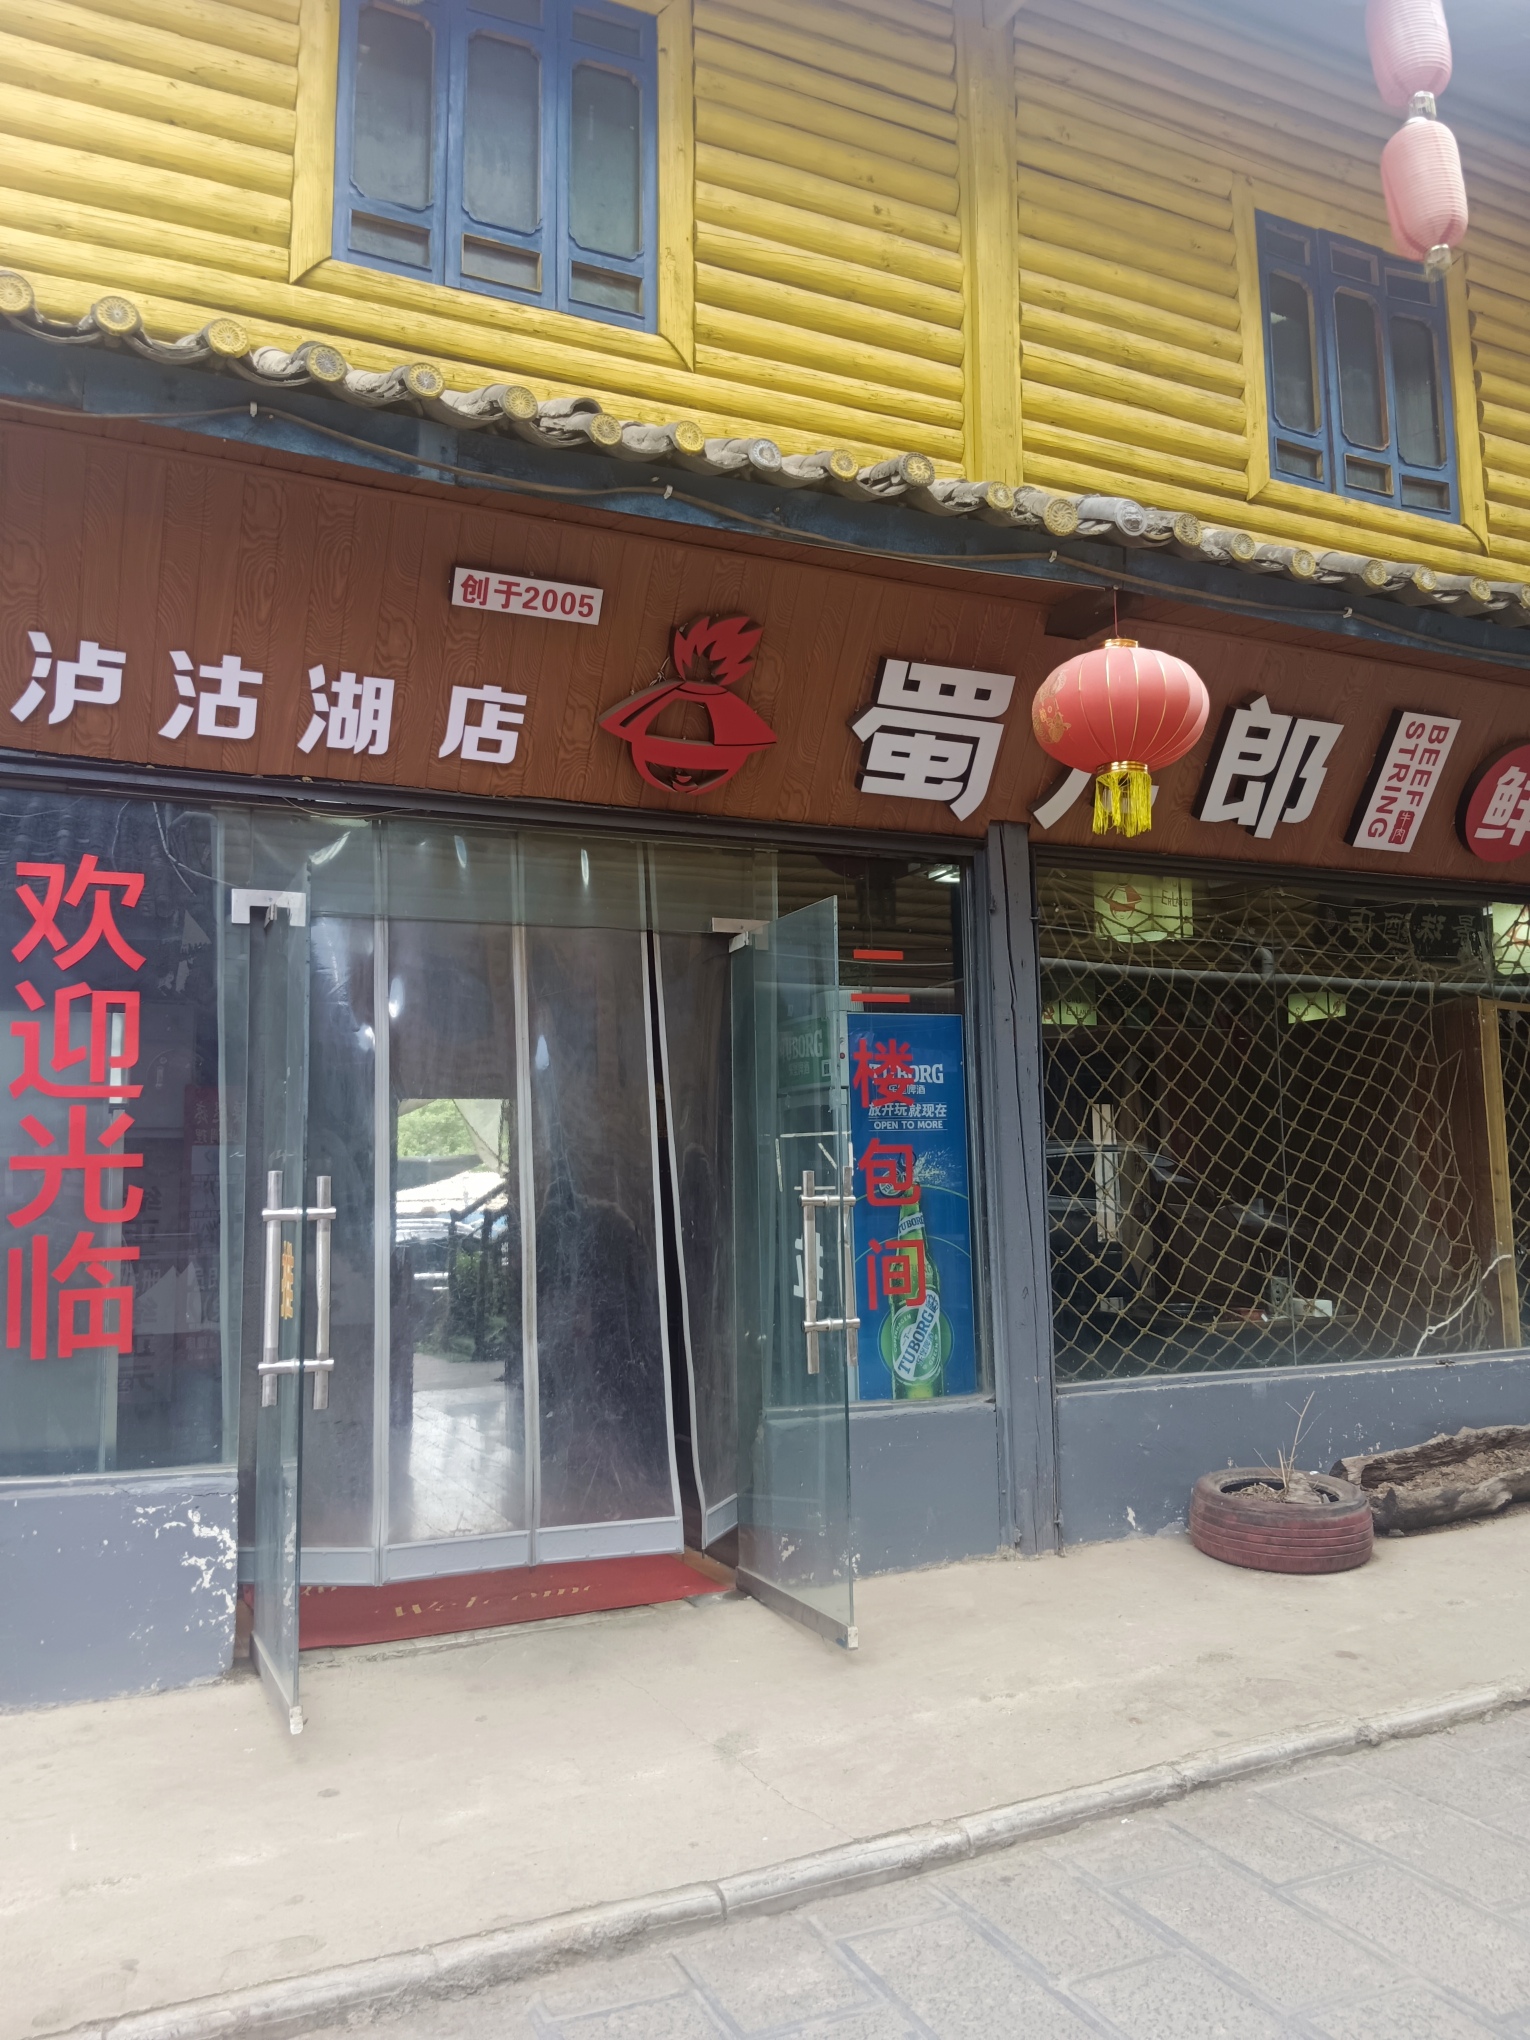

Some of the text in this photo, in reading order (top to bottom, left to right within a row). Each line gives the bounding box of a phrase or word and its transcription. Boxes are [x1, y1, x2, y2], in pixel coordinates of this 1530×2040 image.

[460, 574, 595, 618] 创于2005
[10, 630, 527, 764] 泸沽湖店
[851, 657, 1345, 839] 蜀郎
[1367, 720, 1426, 839] STRING
[1405, 724, 1451, 808] BEEF
[1390, 811, 1413, 843] 牛肉
[5, 853, 147, 1361] 欢迎光临
[850, 949, 928, 1311] 二楼包间
[868, 1102, 948, 1118] 放开玩就现在
[874, 1120, 944, 1130] OPEN TO MORE
[897, 1309, 937, 1375] TUBORG
